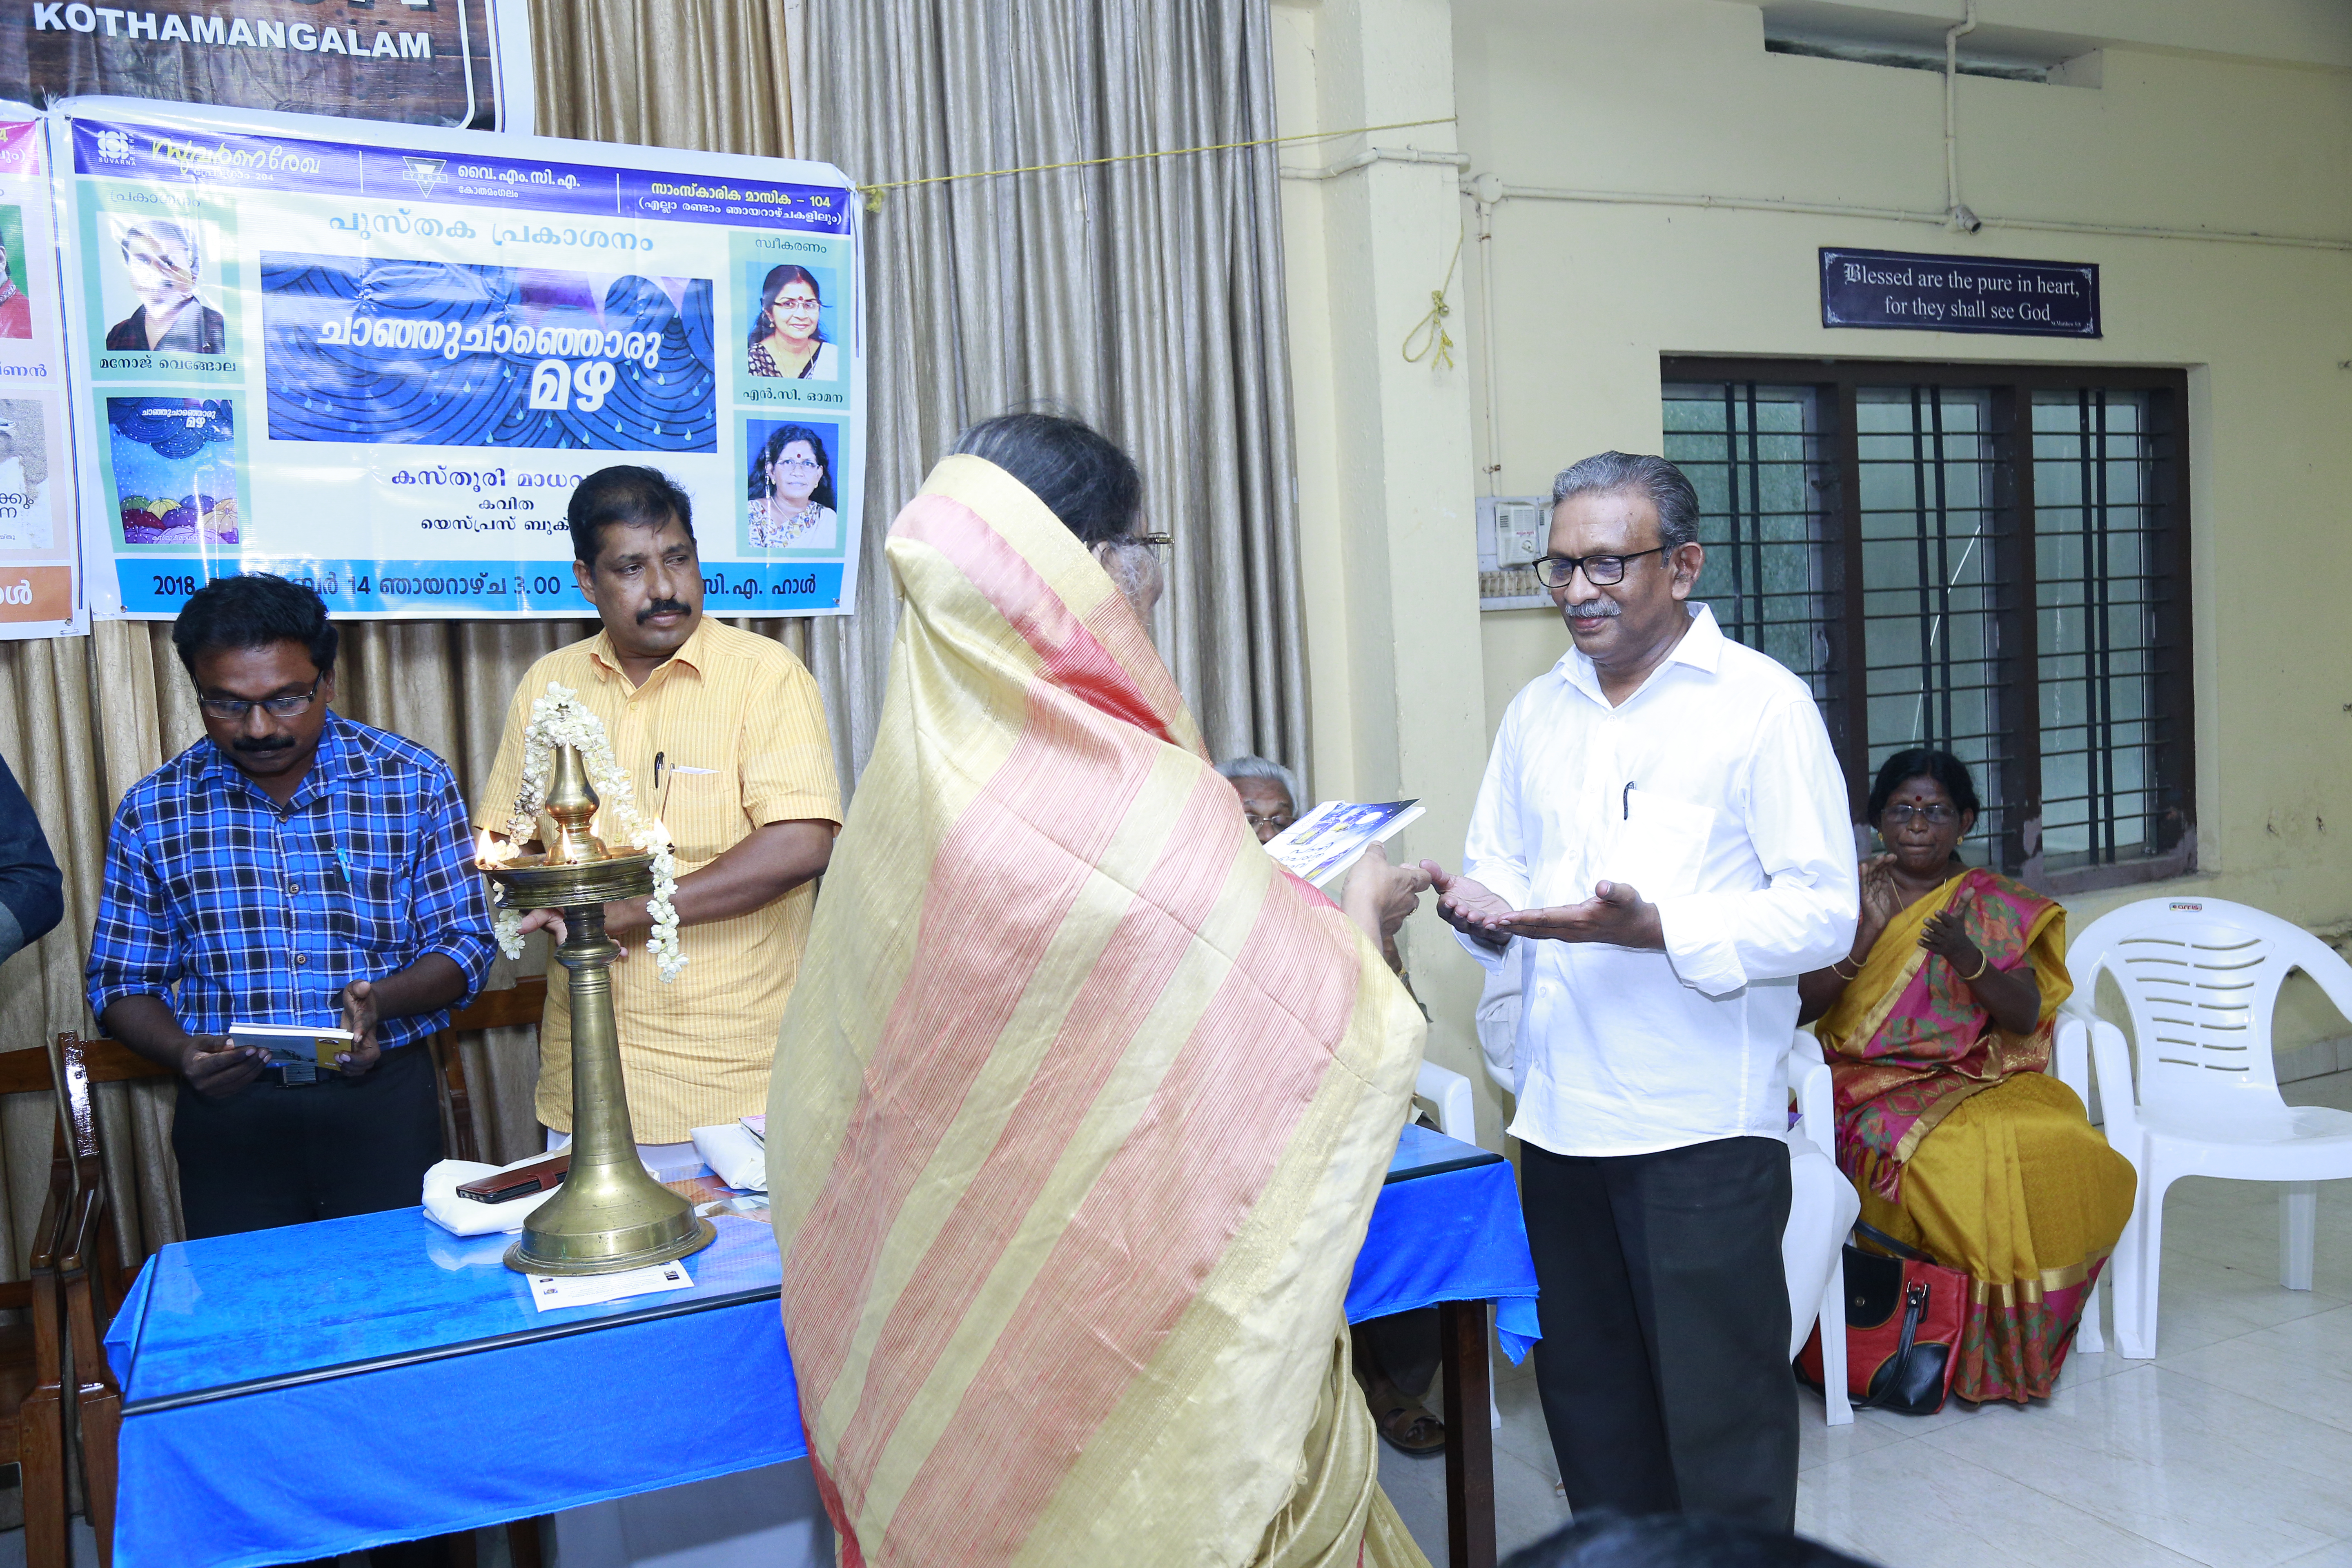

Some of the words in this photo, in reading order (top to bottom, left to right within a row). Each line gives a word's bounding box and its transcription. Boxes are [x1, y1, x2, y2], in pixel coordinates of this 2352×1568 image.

[33, 2, 431, 58] KOTHAMANGALAM
[99, 157, 136, 166] SUVARNA
[256, 173, 274, 181] 204
[409, 173, 442, 181] YMCA
[458, 185, 519, 198] കോതമംഗലം
[651, 182, 742, 201] സാംസ്കാരിക
[745, 189, 791, 205] മാസിക
[810, 195, 831, 207] 104
[639, 196, 677, 214] (എല്ലാ
[683, 202, 722, 213] രണ്ടാം
[330, 208, 477, 240] പുസ്തക
[492, 223, 653, 252] പ്രകാശനം
[755, 238, 827, 254] സ്വീകരണം
[1843, 263, 1913, 286] Blessed
[1918, 275, 1943, 287] are
[1949, 270, 1972, 289] the
[1978, 277, 2012, 294] pure
[2018, 274, 2032, 292] in
[2037, 278, 2080, 298] heart,
[1885, 295, 1908, 314] for
[1913, 297, 1945, 321] they
[1951, 299, 1985, 318] shall
[1991, 306, 2014, 320] see
[2019, 301, 2050, 321] God
[100, 354, 152, 368] മനോജ്
[529, 358, 617, 412] മഴ
[807, 392, 843, 403] ഓമന
[186, 416, 206, 428] മഴ
[391, 465, 506, 492] കസ്തൂരി
[479, 497, 534, 510] കവിത
[524, 516, 569, 535] ബുക്
[153, 575, 195, 596] 2018
[348, 576, 371, 595] 14
[379, 572, 507, 595] ഞായറാഴ്ച
[514, 575, 560, 595] 3.00
[772, 573, 816, 595] ഹാൾ
